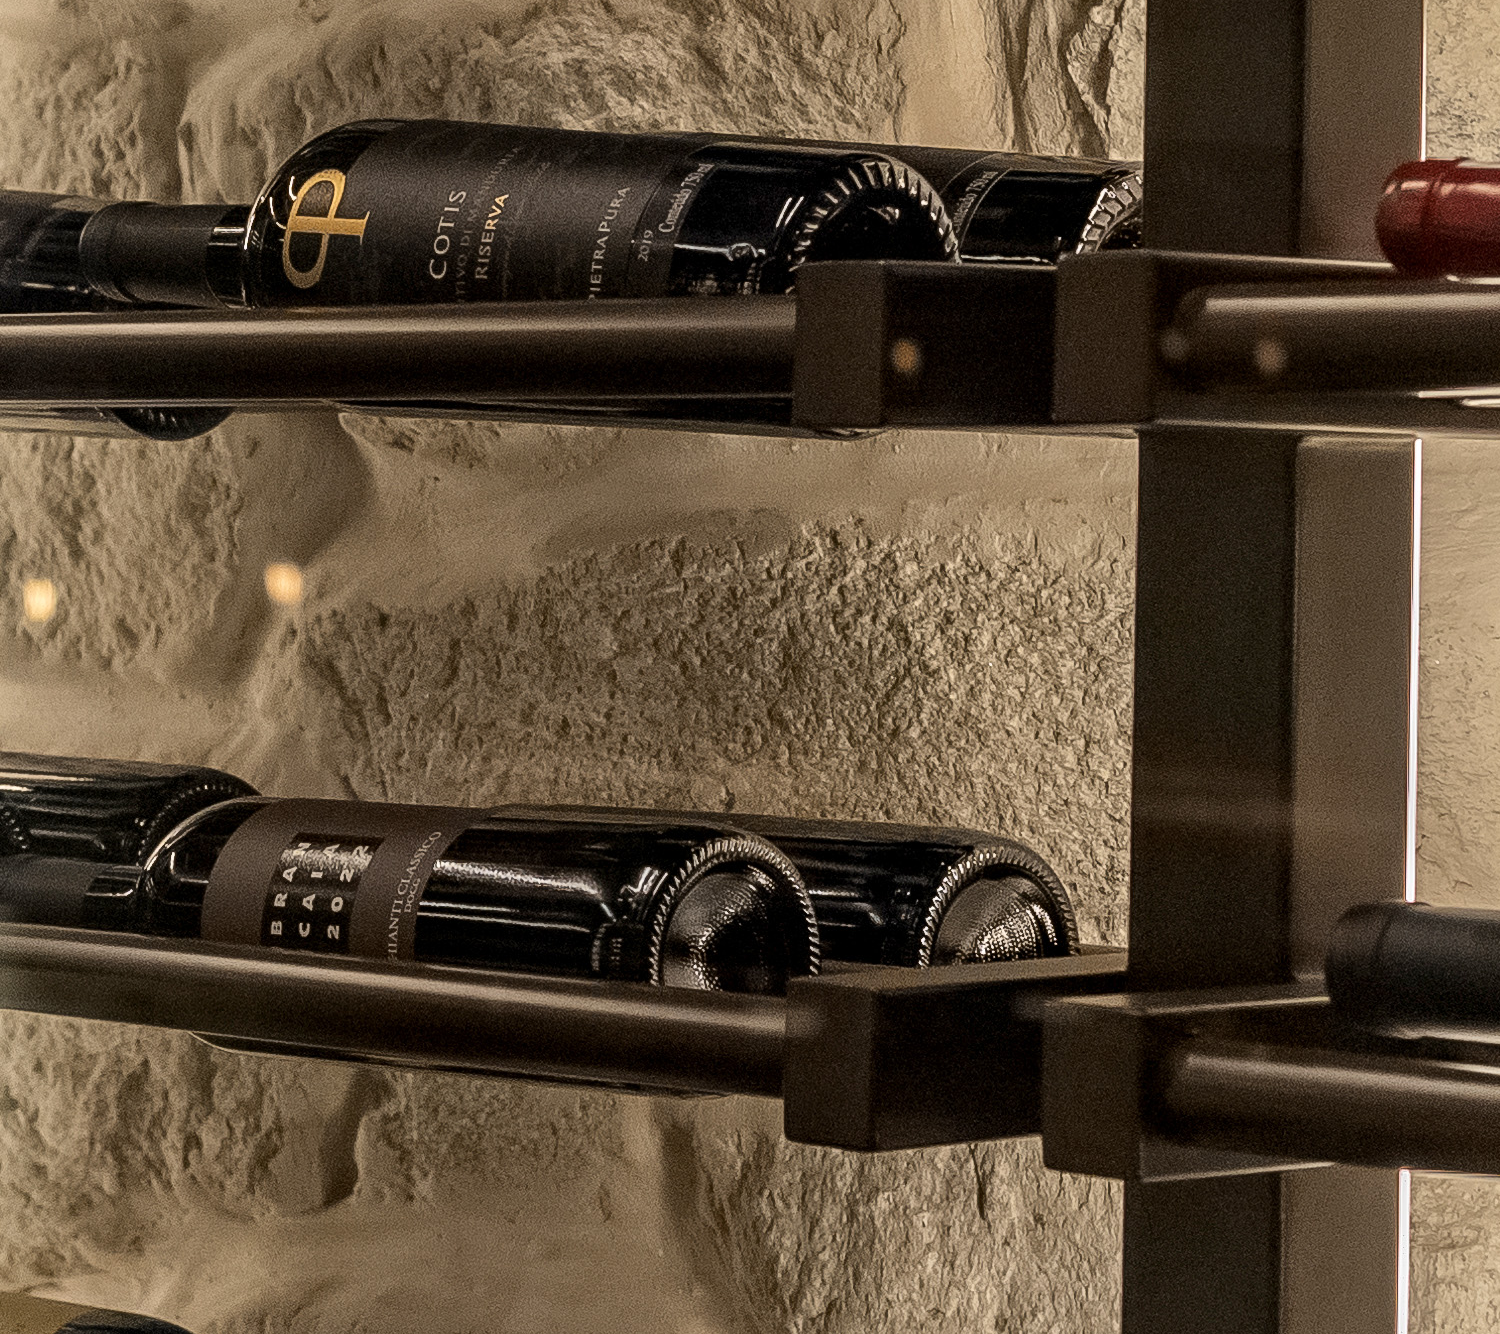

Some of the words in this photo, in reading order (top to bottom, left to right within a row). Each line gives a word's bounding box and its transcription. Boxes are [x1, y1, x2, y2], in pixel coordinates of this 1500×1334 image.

[428, 188, 468, 280] COTIS
[473, 193, 511, 280] RISERVA
[270, 842, 312, 937] BRAN
[298, 843, 341, 939] CAIA
[326, 844, 373, 941] 2022
[397, 831, 443, 897] CLASSICO
